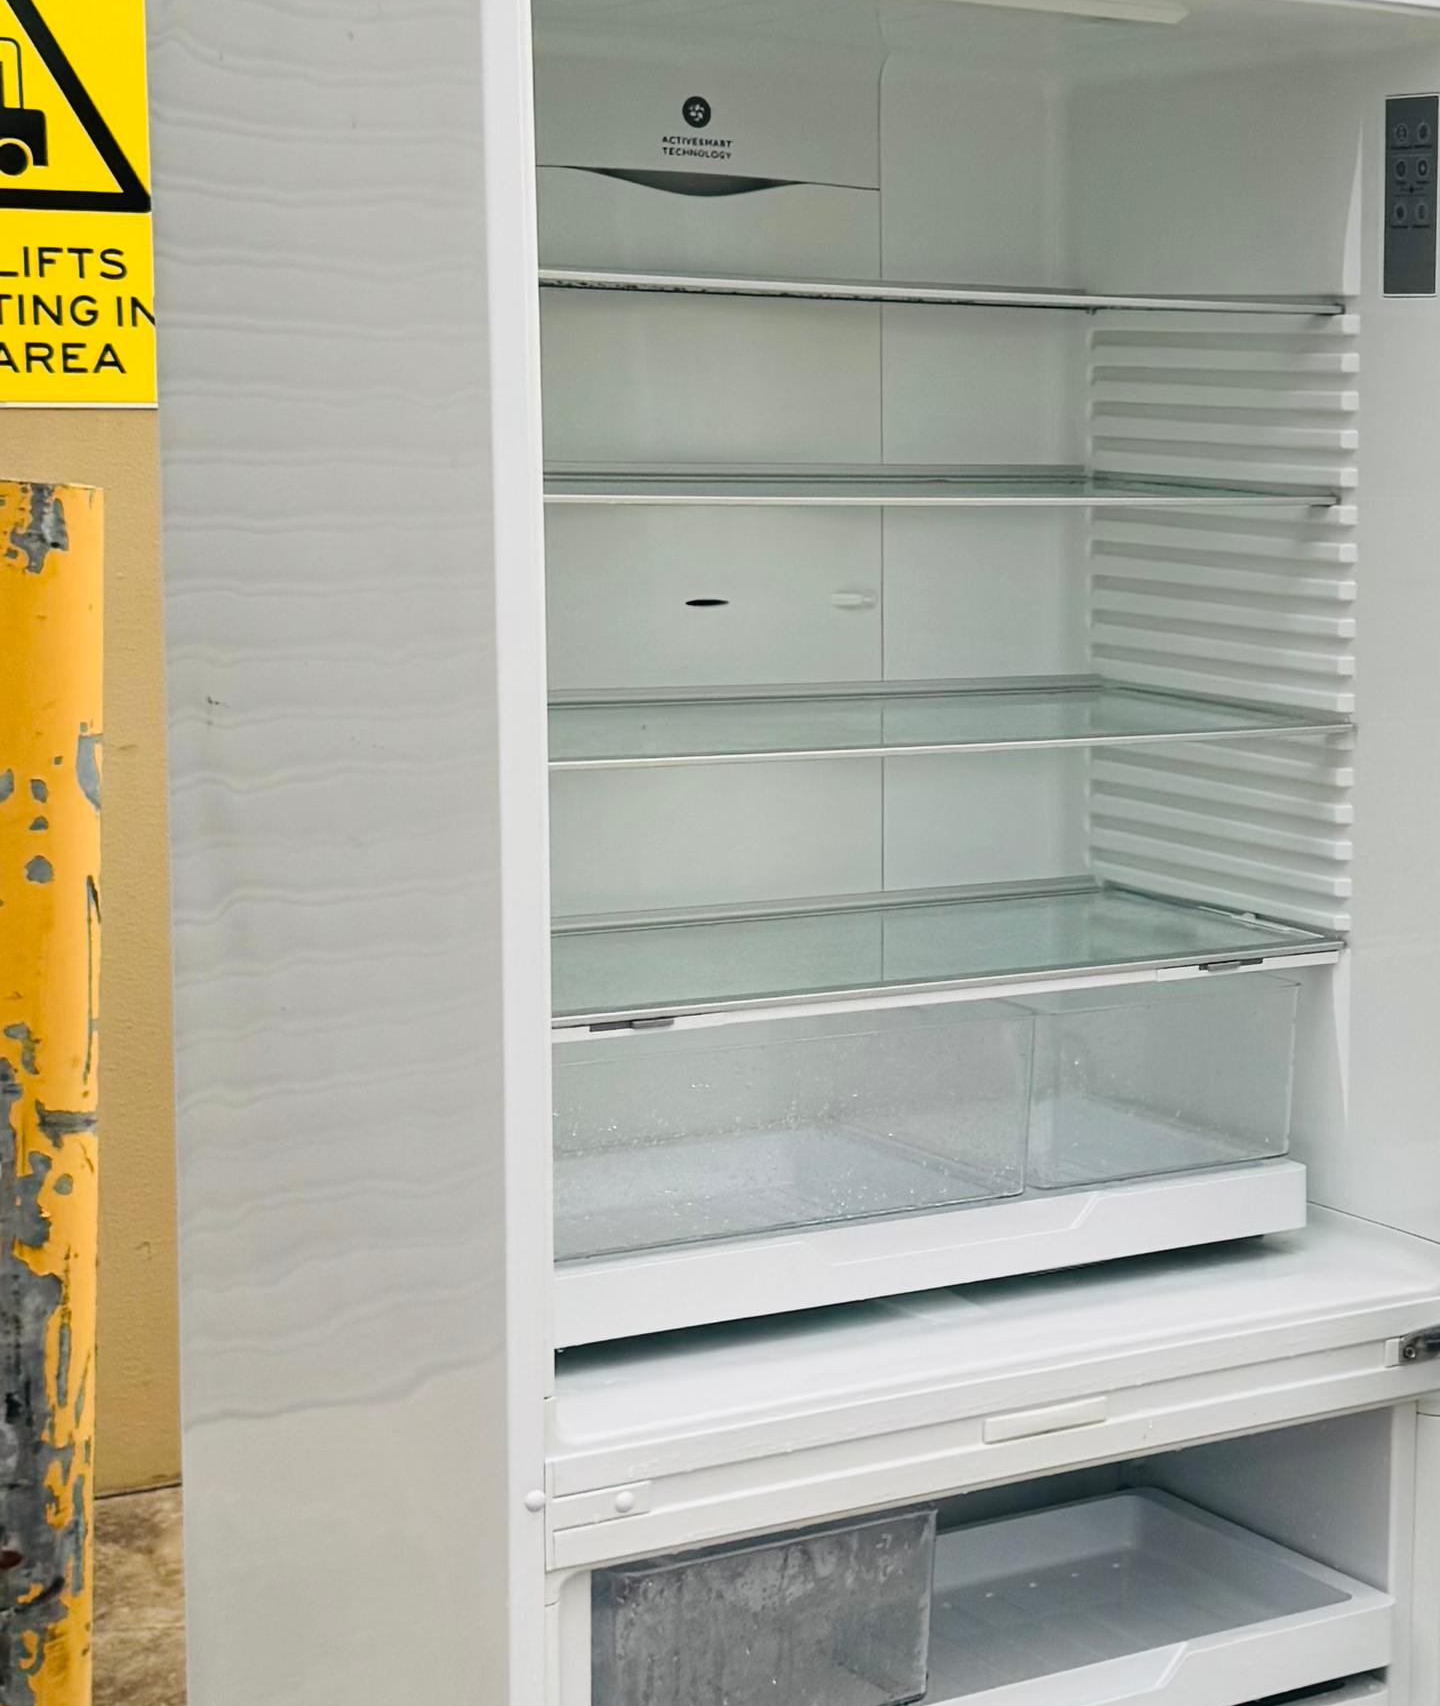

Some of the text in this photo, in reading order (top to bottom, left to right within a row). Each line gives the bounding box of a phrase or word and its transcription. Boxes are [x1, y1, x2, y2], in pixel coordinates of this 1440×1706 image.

[662, 136, 733, 147] ACTIVESMART
[662, 147, 732, 160] TECHNOLOGY
[0, 342, 126, 374] AREA
